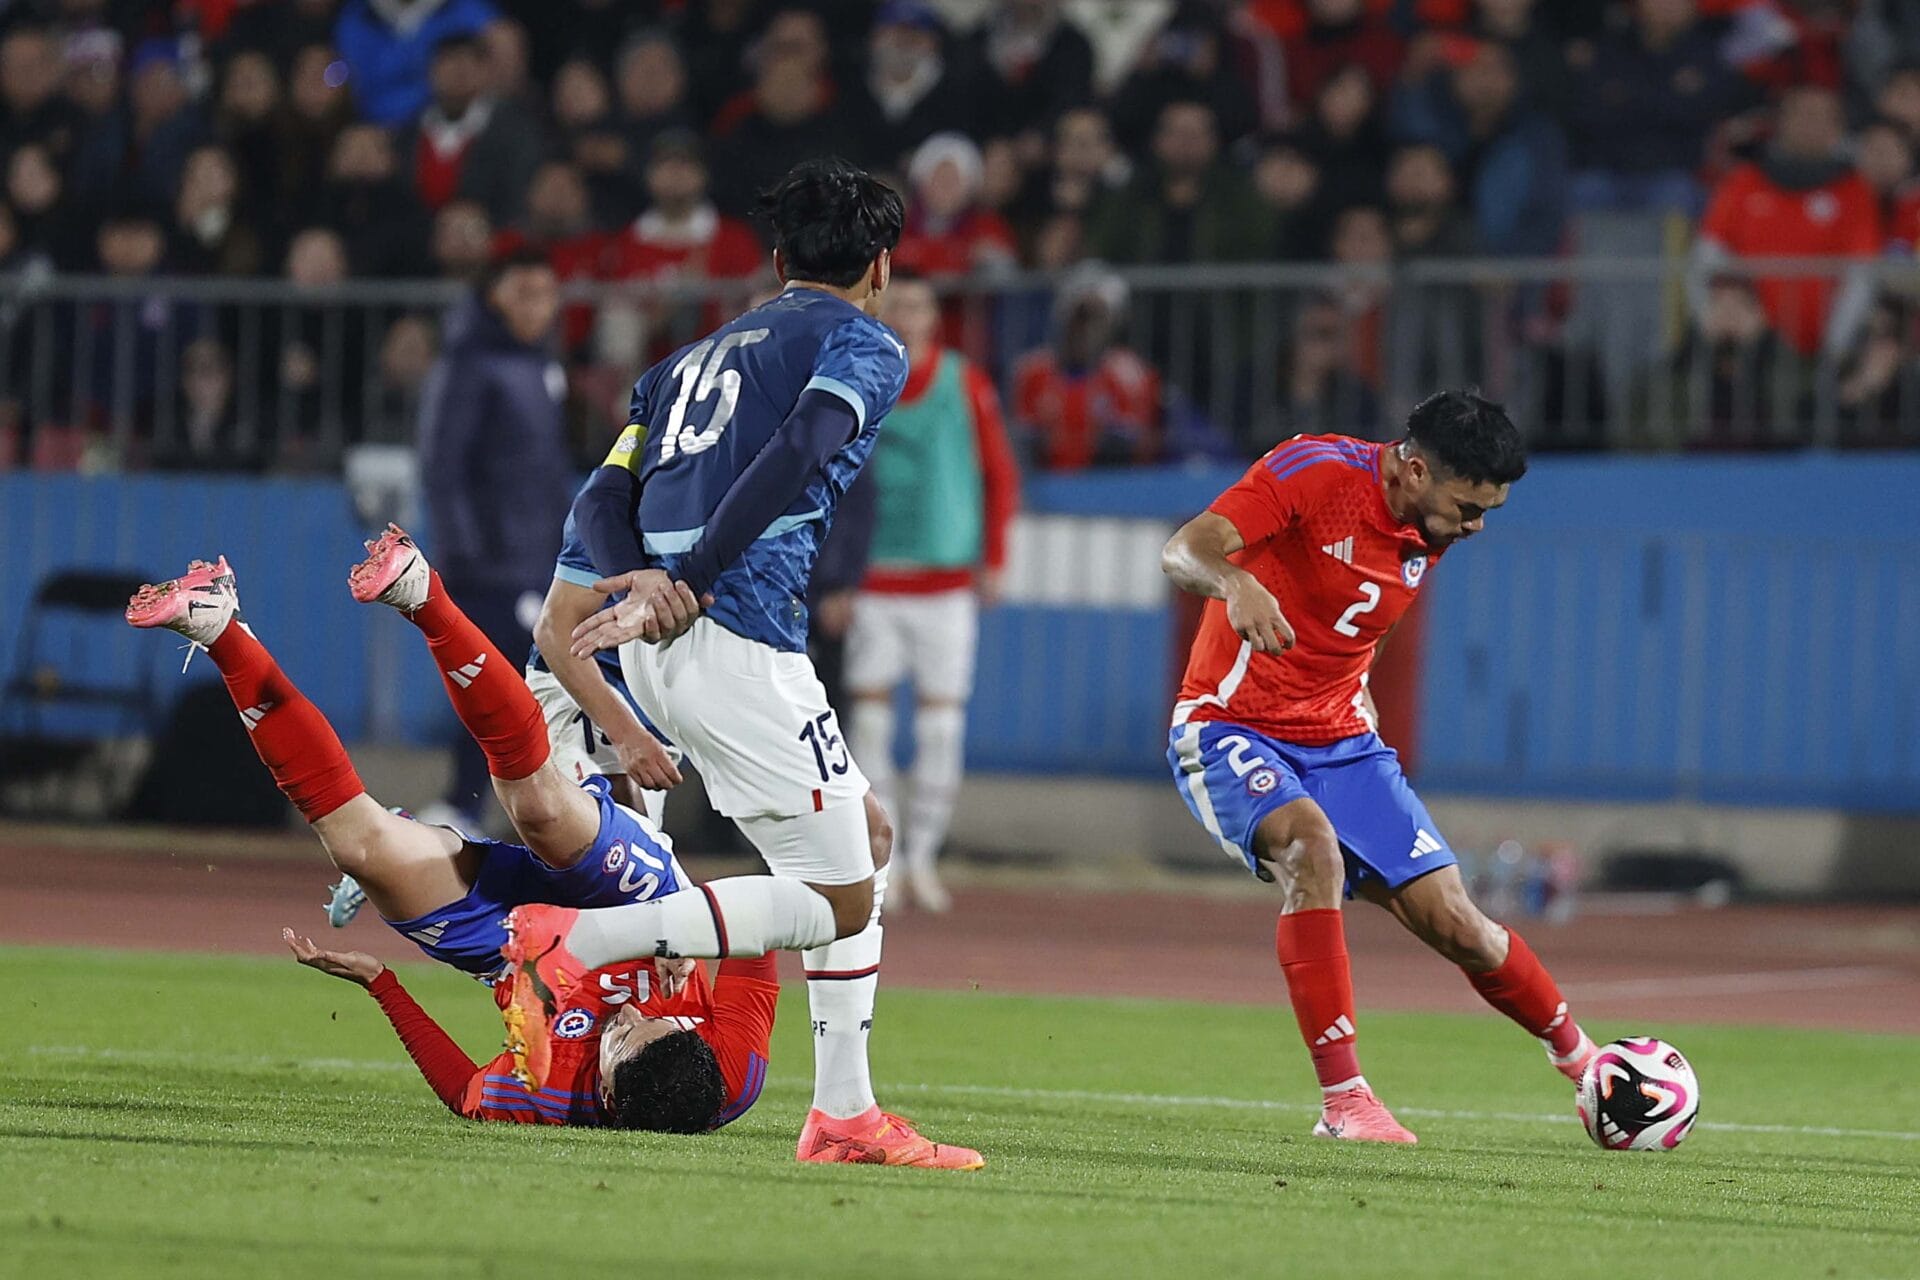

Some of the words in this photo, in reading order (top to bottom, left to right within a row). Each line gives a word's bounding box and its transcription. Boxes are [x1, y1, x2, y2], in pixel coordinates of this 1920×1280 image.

[657, 328, 770, 465] 15
[1333, 581, 1380, 638] 2
[573, 710, 613, 754] 1
[799, 710, 848, 782] 15
[1216, 734, 1265, 777] 2
[618, 842, 665, 901] 15
[600, 969, 650, 1004] 15
